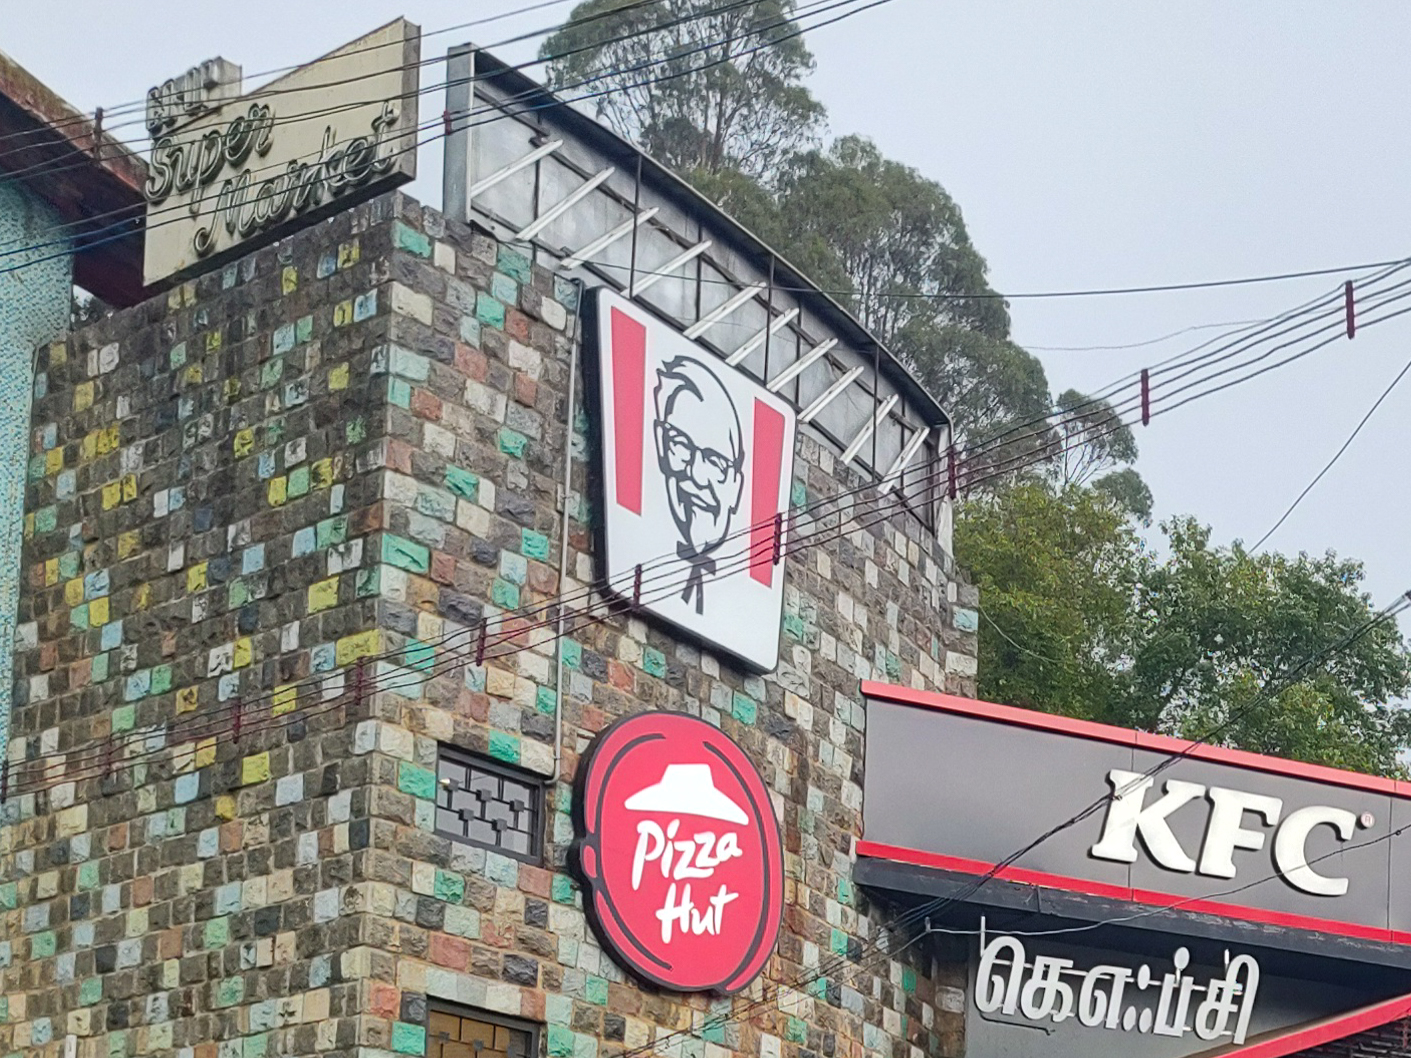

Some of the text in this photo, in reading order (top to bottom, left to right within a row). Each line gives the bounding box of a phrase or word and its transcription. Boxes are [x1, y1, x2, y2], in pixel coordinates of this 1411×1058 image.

[144, 102, 275, 221] Super
[193, 100, 400, 255] Market
[631, 818, 743, 891] Pizza
[1089, 768, 1357, 897] KFC
[655, 884, 739, 944] Hut
